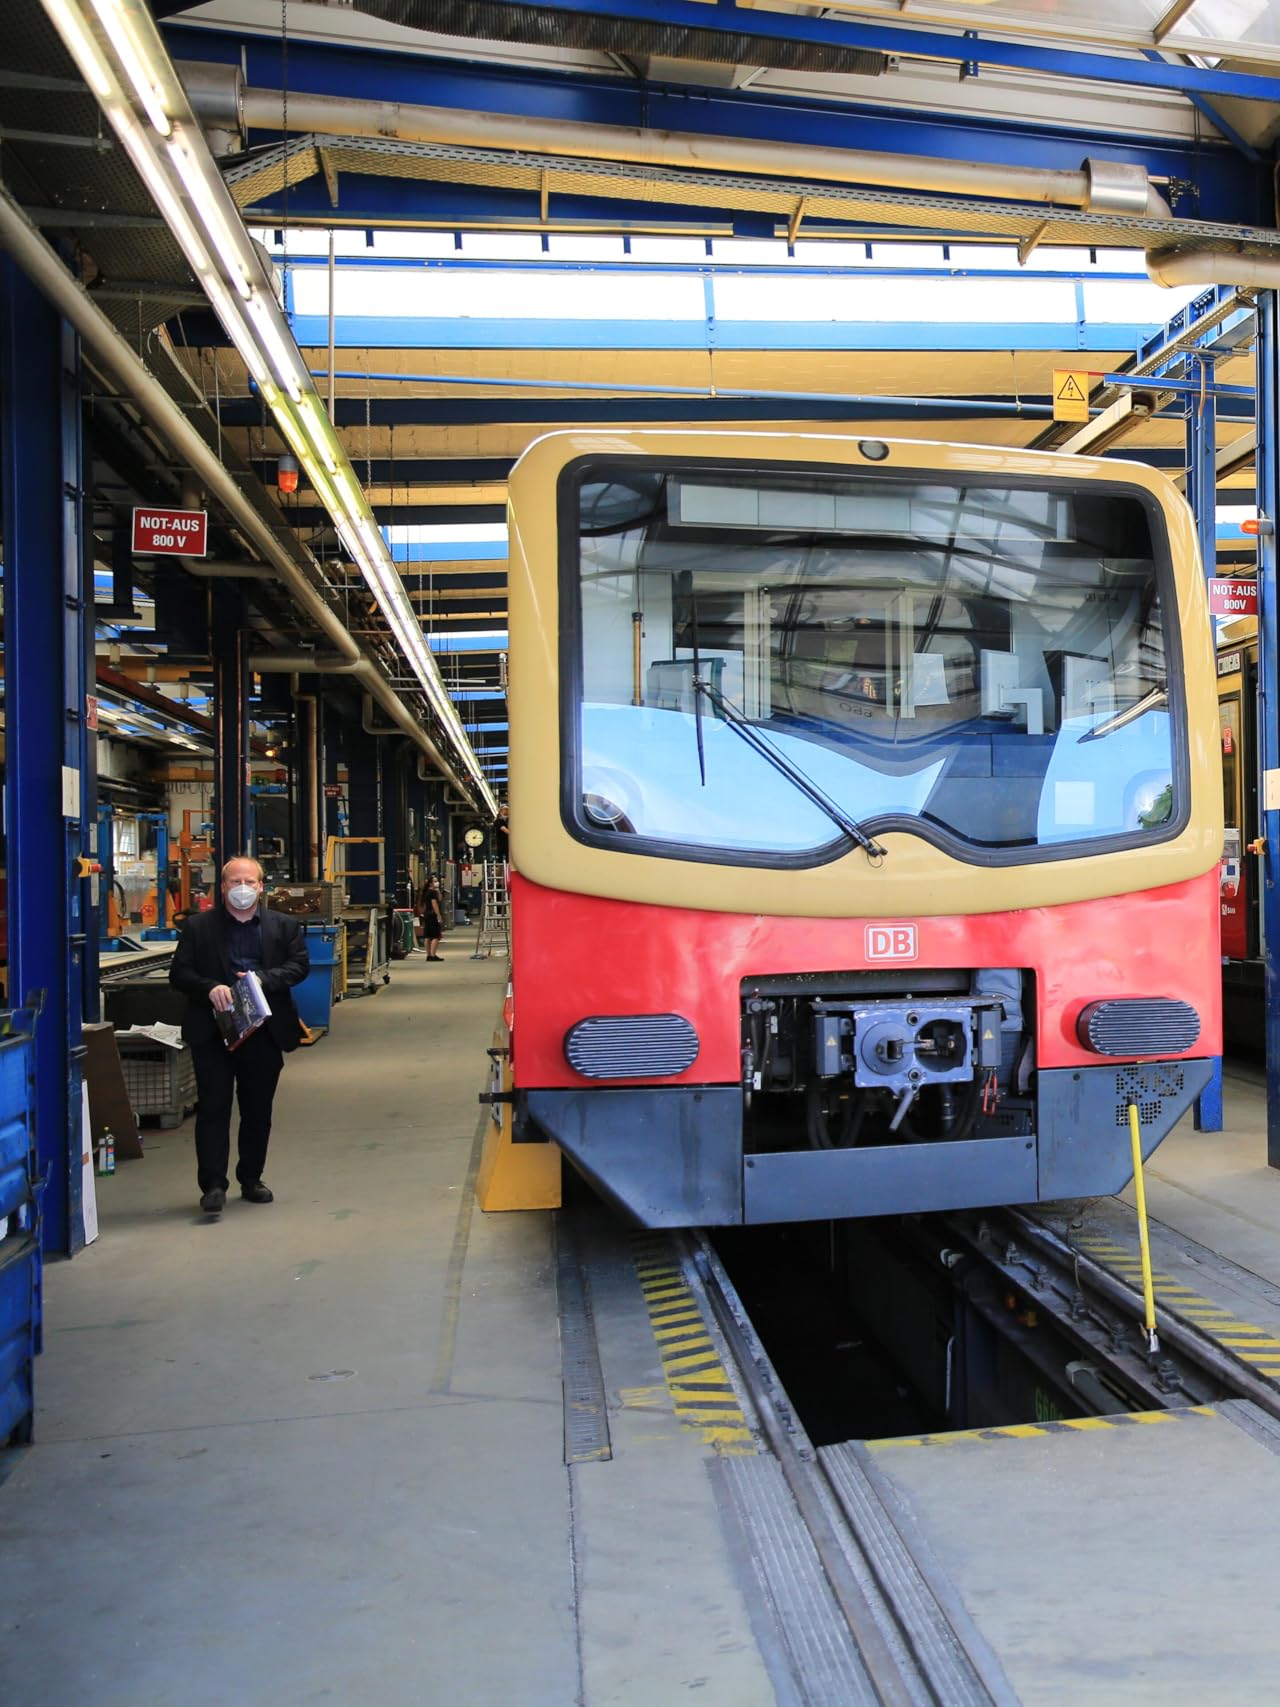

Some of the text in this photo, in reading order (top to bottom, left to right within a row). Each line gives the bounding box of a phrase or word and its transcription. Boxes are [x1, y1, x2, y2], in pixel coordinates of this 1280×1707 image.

[140, 516, 200, 532] NOT-AUS
[152, 534, 187, 548] 800 V
[1212, 584, 1257, 597] NOT-AUS
[871, 929, 912, 956] DB
